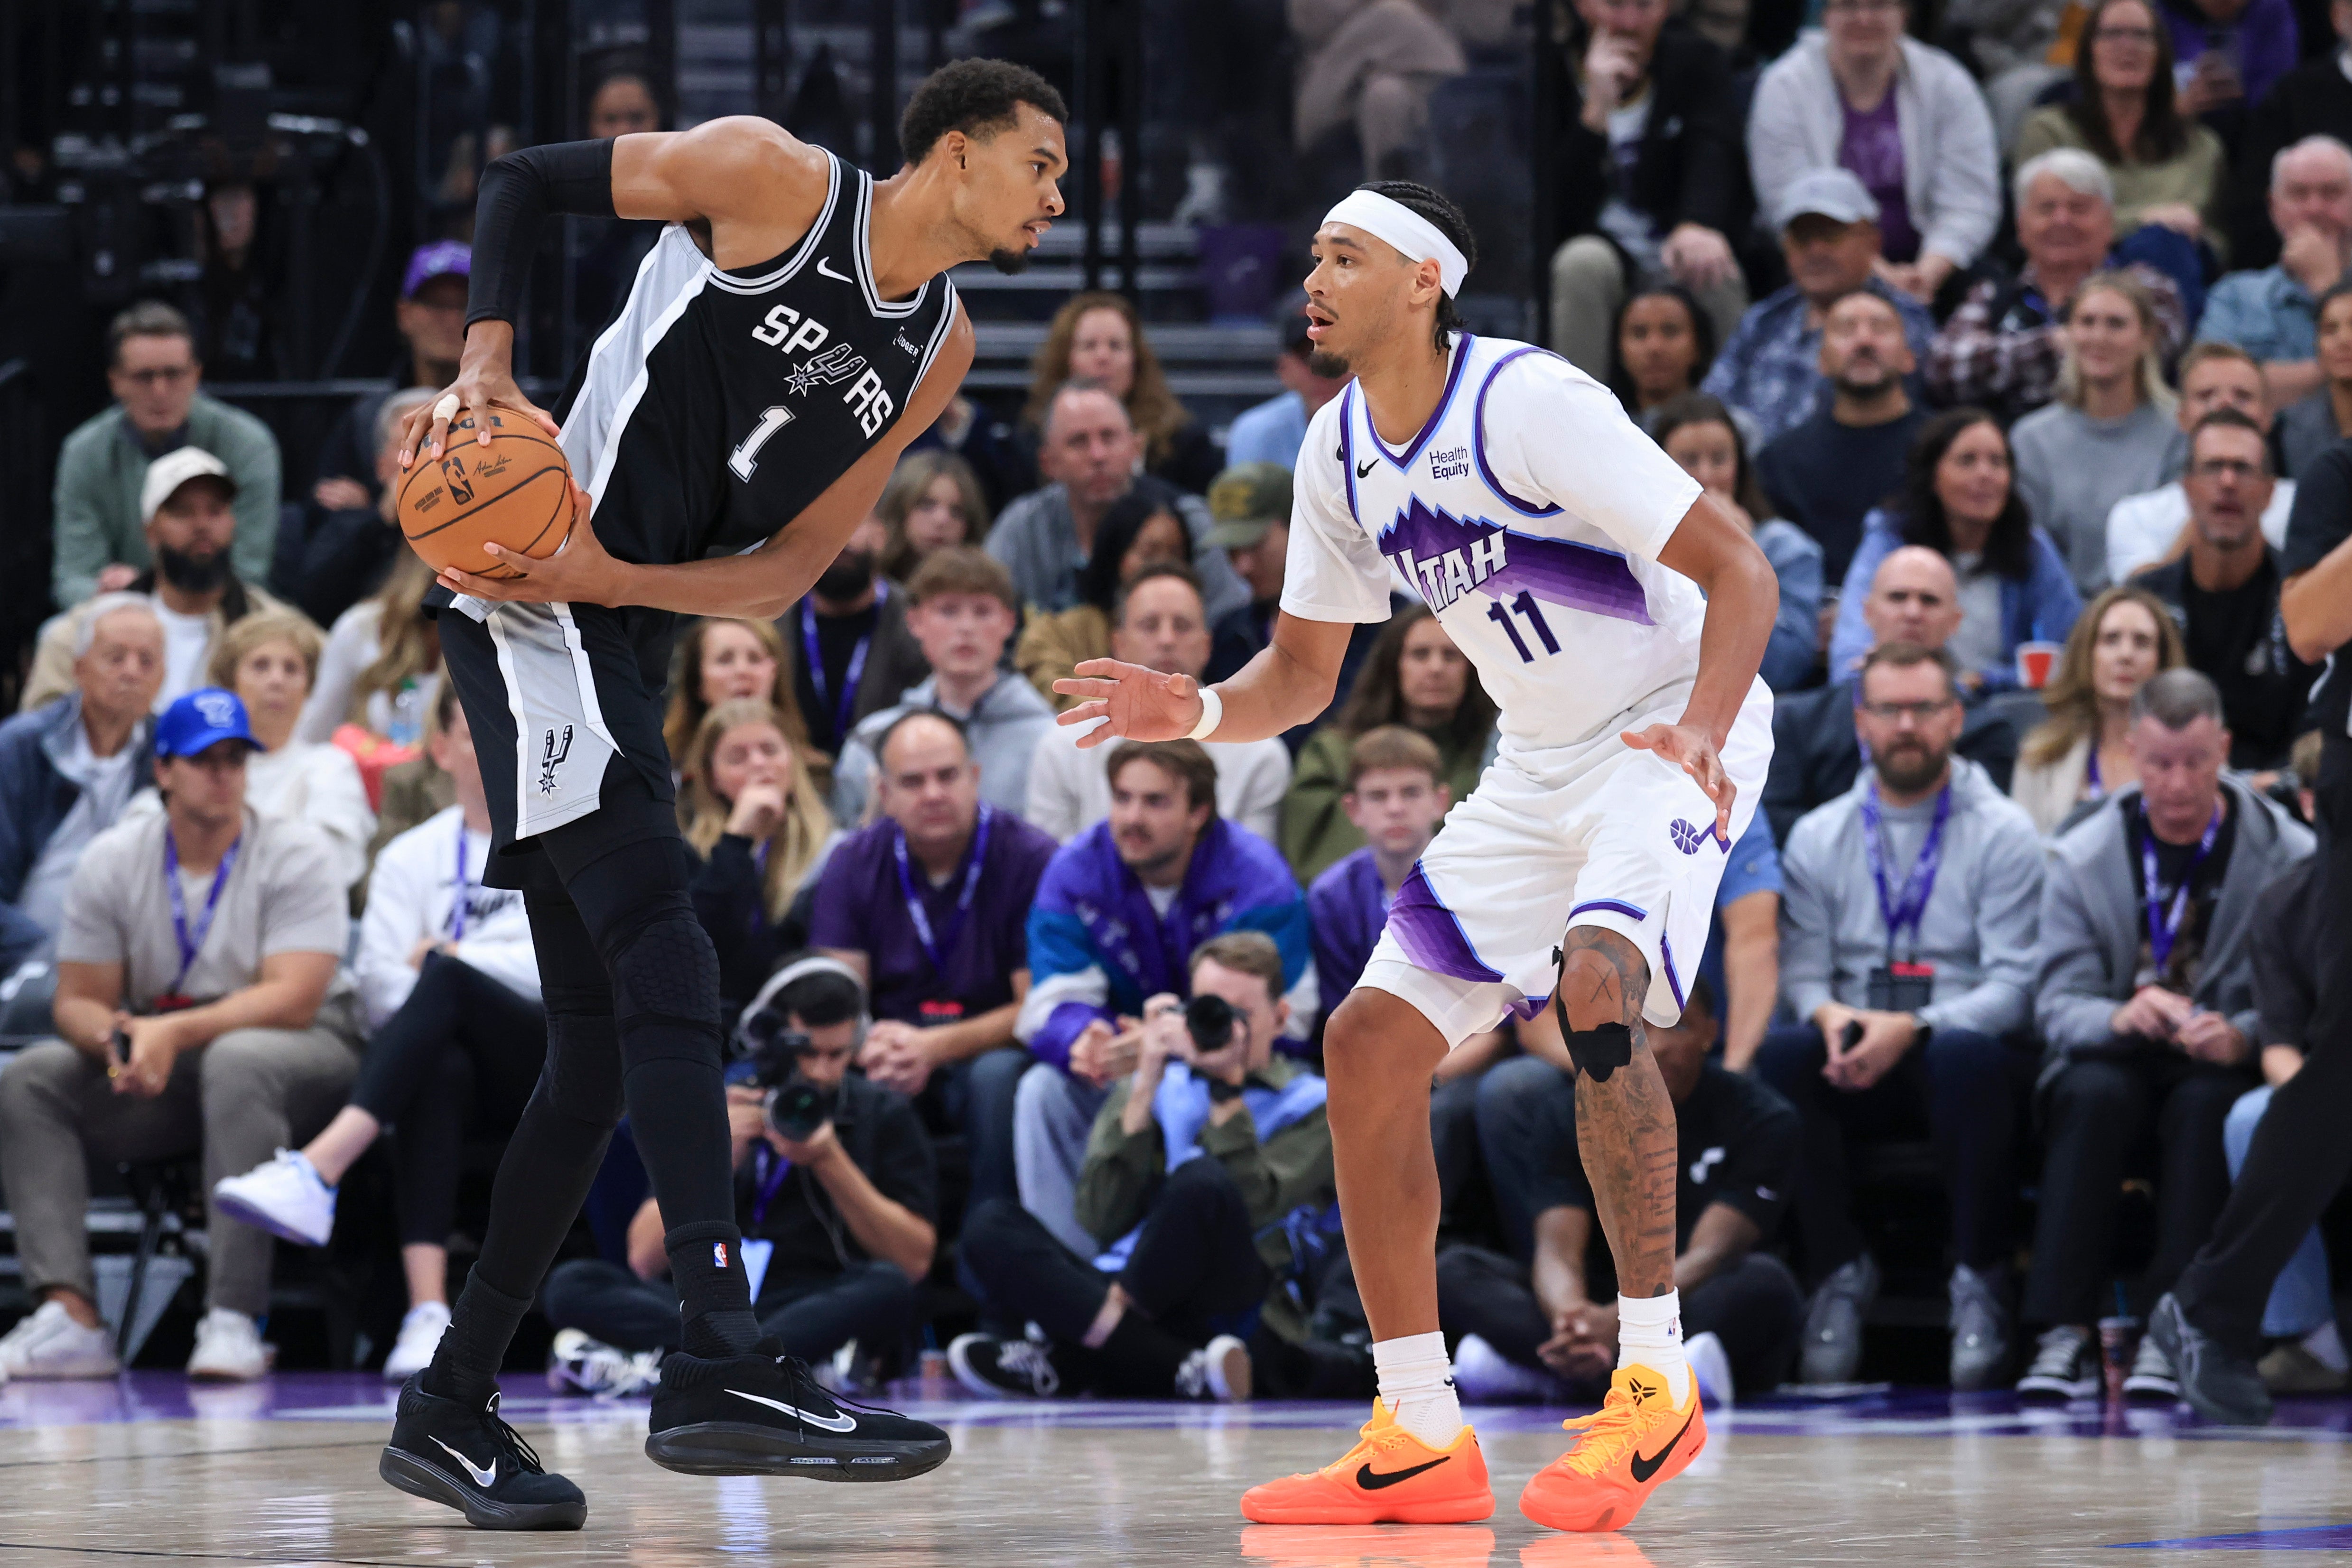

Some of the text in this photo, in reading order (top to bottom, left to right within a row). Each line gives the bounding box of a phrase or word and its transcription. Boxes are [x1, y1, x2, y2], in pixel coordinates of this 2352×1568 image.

[897, 334, 919, 357] LEDGER
[727, 406, 796, 484] 1
[1429, 445, 1468, 465] Health
[1432, 462, 1469, 481] Equity
[1486, 589, 1562, 664] 11
